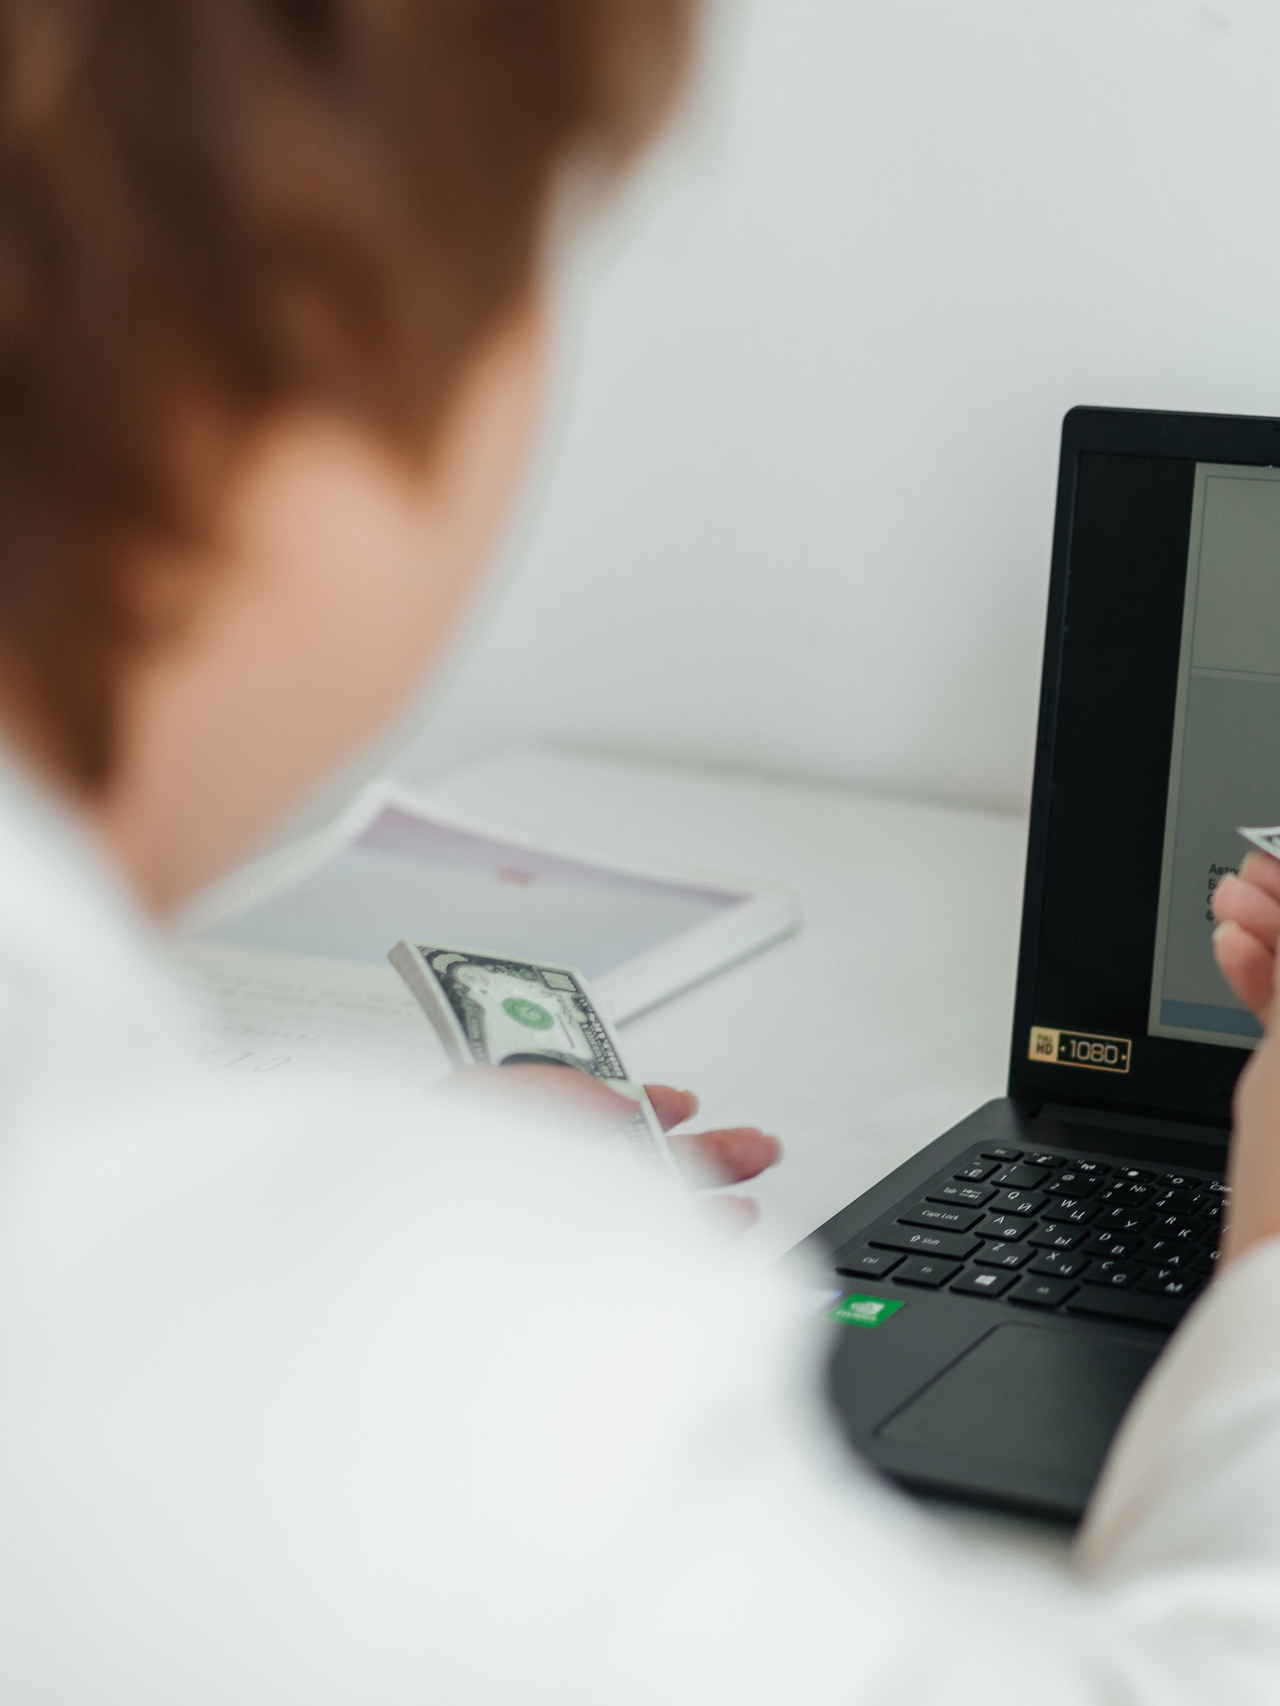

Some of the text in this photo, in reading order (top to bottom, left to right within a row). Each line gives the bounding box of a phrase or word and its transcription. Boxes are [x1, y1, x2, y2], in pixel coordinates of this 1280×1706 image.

[1036, 1040, 1118, 1064] HD 1080
[1007, 1191, 1020, 1200] Q
[1061, 1199, 1077, 1208] W
[921, 1209, 960, 1221] Caps Lock
[1099, 1232, 1112, 1240] D
[921, 1237, 940, 1246] Shift
